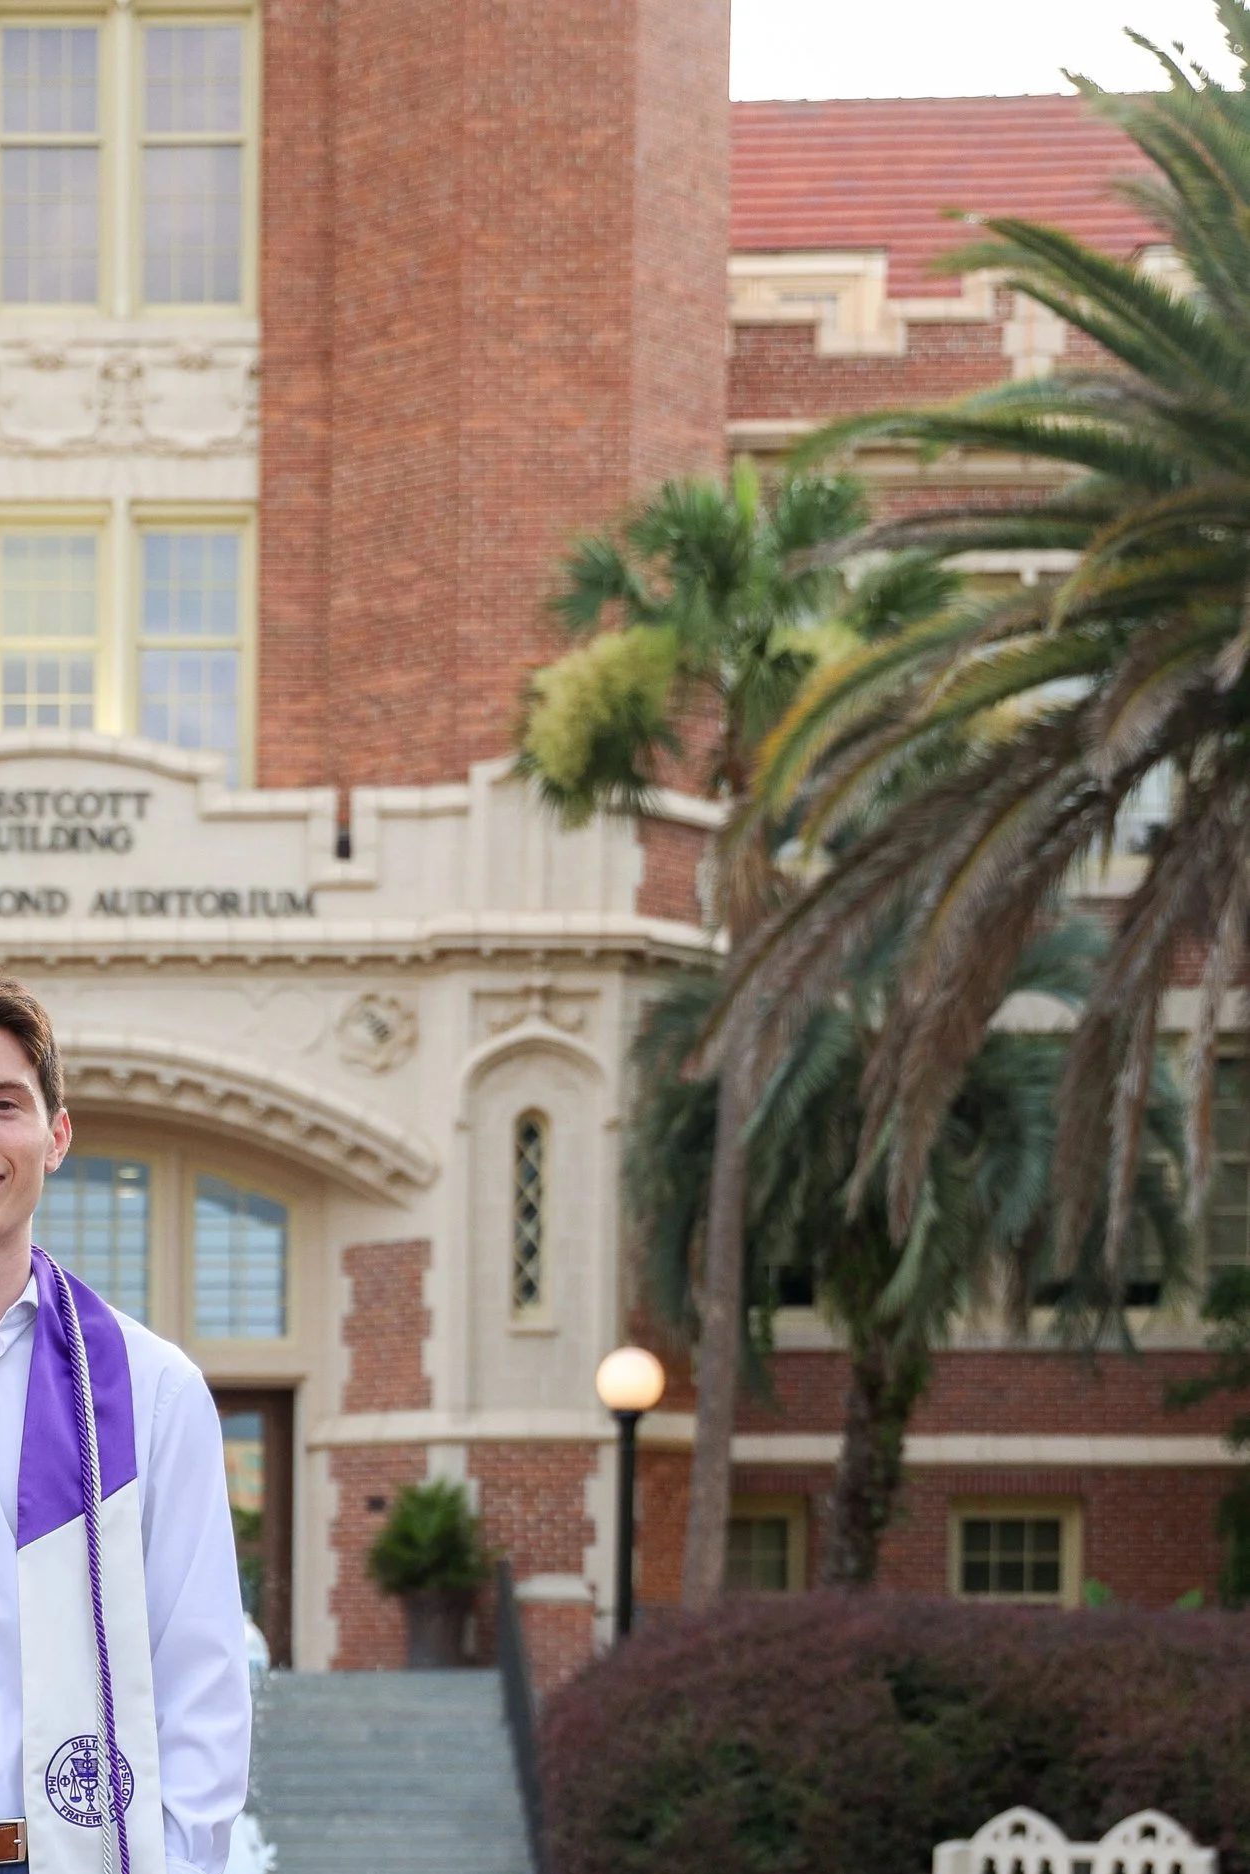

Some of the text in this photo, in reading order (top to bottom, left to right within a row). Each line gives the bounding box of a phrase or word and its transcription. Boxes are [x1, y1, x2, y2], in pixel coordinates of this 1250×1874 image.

[89, 887, 317, 917] AUDITORIUM
[48, 1775, 58, 1795] PHI
[71, 1738, 100, 1751] DELT
